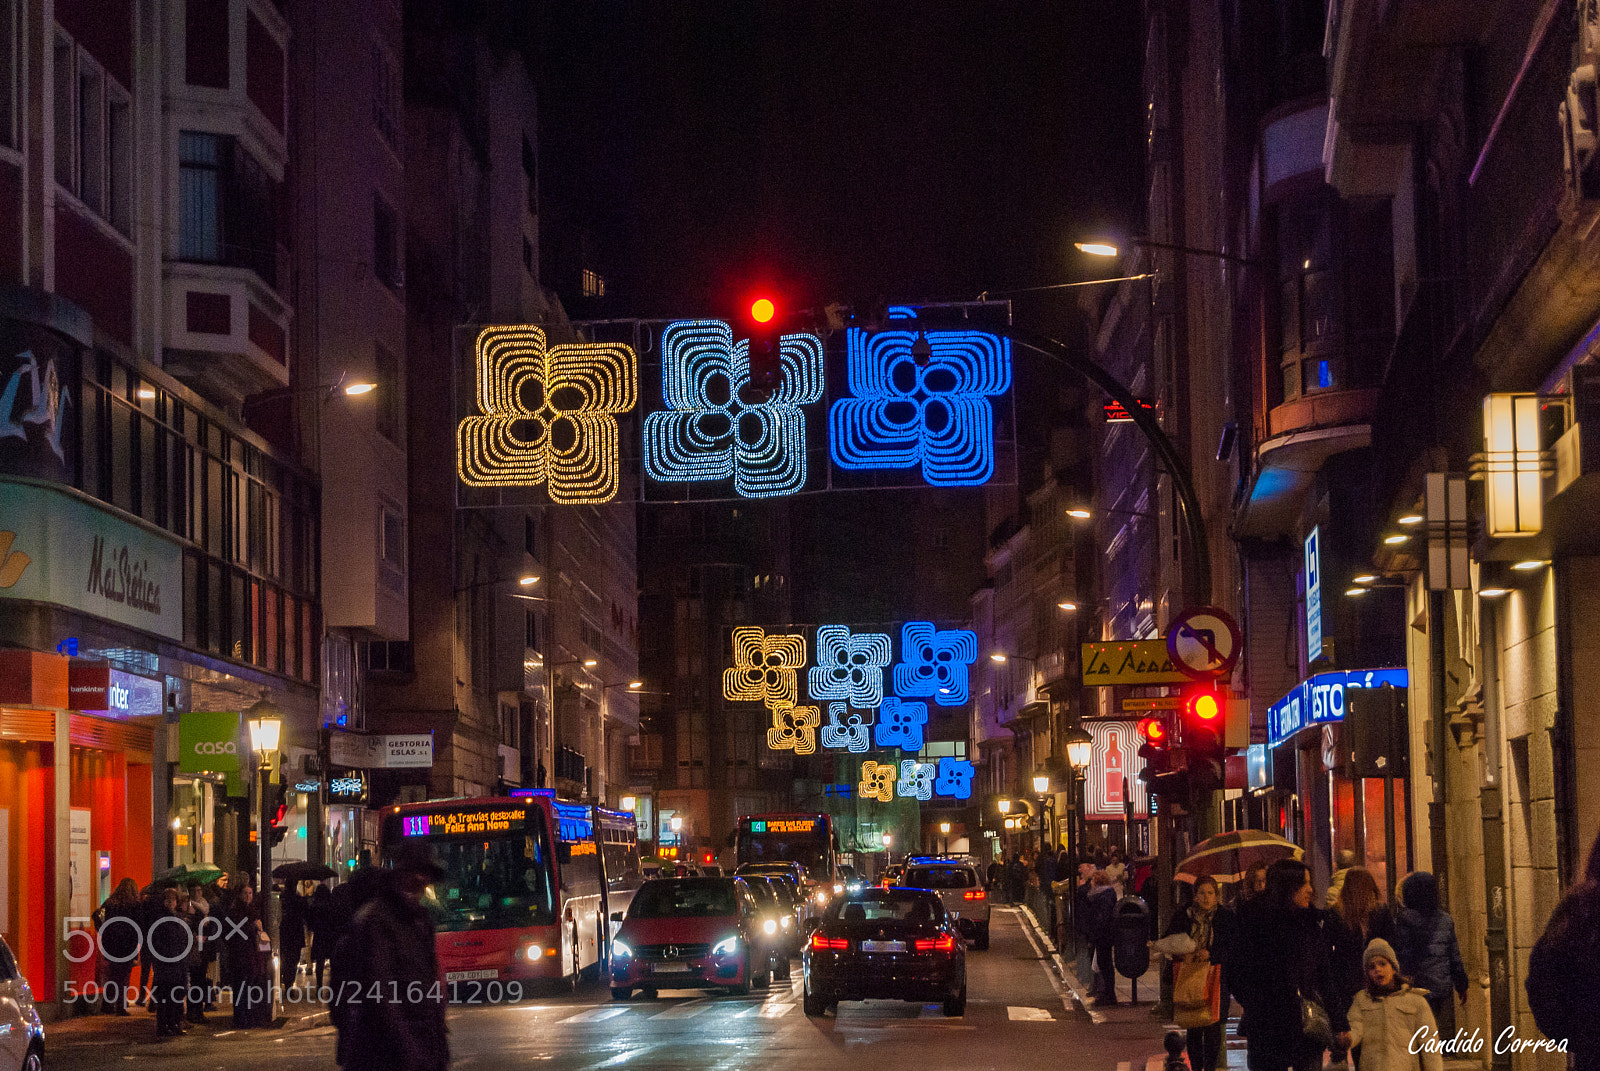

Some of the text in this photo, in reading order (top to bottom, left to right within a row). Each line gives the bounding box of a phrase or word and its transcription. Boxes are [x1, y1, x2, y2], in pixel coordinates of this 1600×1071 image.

[1085, 651, 1110, 675] La
[194, 741, 237, 755] casa
[388, 740, 431, 748] GESTORIA
[448, 812, 457, 824] de
[409, 816, 424, 835] 11
[445, 820, 510, 834] Feliz Ano Novo
